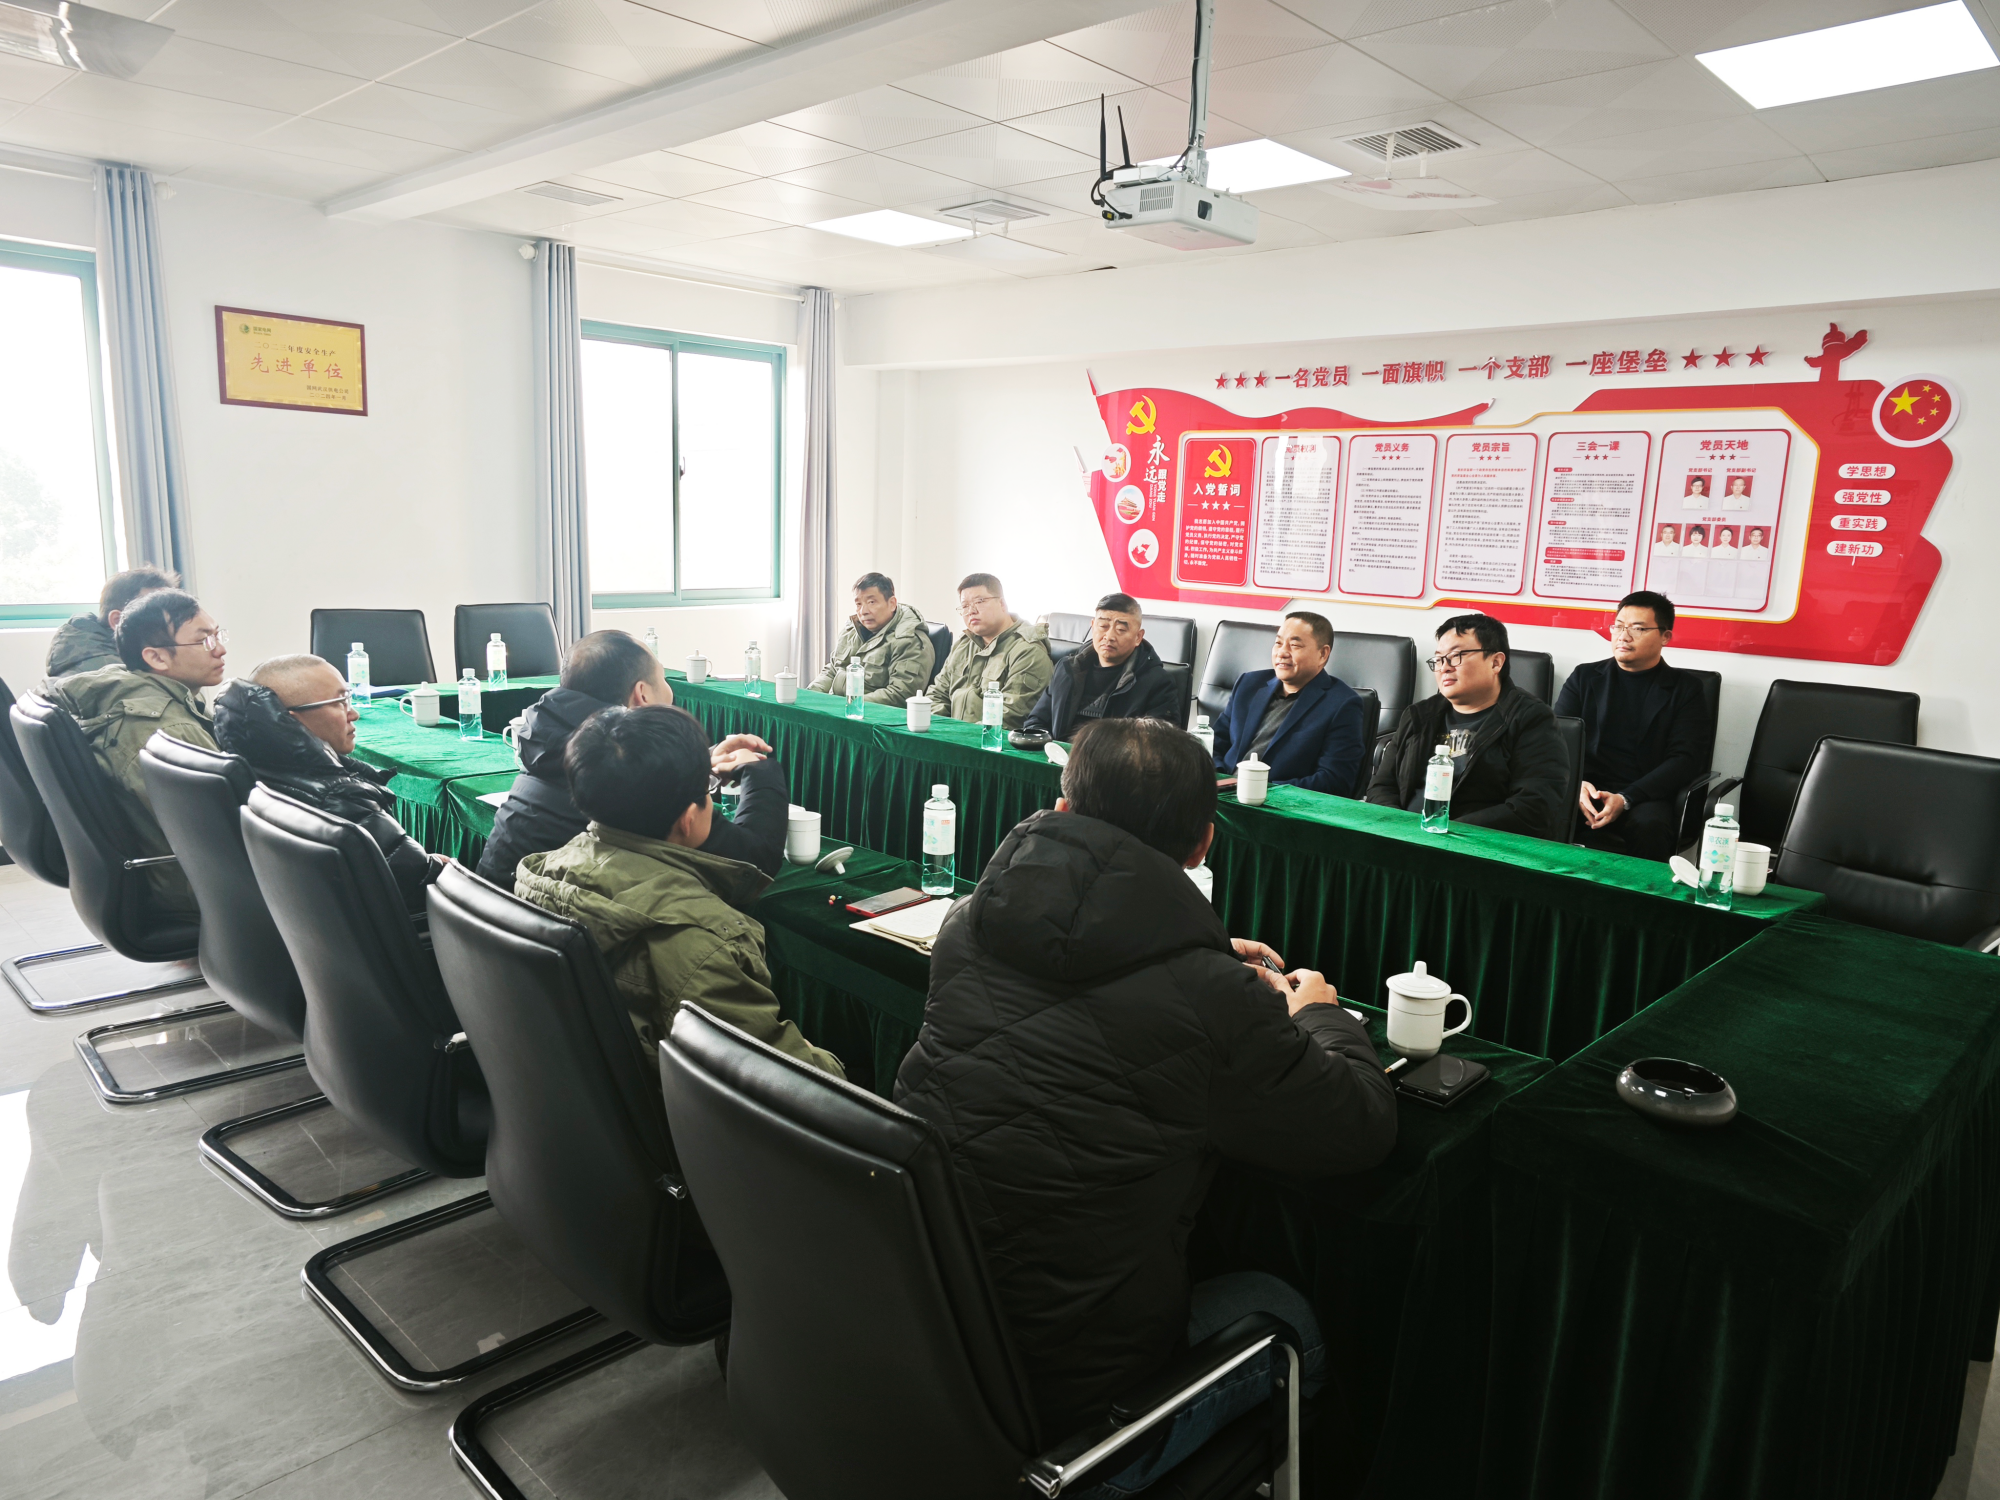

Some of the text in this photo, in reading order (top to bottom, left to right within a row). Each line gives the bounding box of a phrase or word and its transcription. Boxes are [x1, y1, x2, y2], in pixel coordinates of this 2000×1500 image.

[250, 352, 343, 379] 先进单位
[1274, 348, 1669, 388] 一名党员 一面旗帜 一个支部 一座堡垒
[1374, 443, 1410, 452] 党员义务
[1471, 442, 1511, 452] 党员宗旨
[1576, 441, 1620, 451] 三会一课
[1699, 439, 1749, 451] 党员天地
[1846, 466, 1887, 477] 学思想
[1156, 468, 1168, 503] 跟党走
[1193, 482, 1241, 497] 入党誓词
[1842, 491, 1883, 504] 强党性
[1838, 517, 1879, 530] 重实践
[1834, 543, 1875, 555] 建新功
